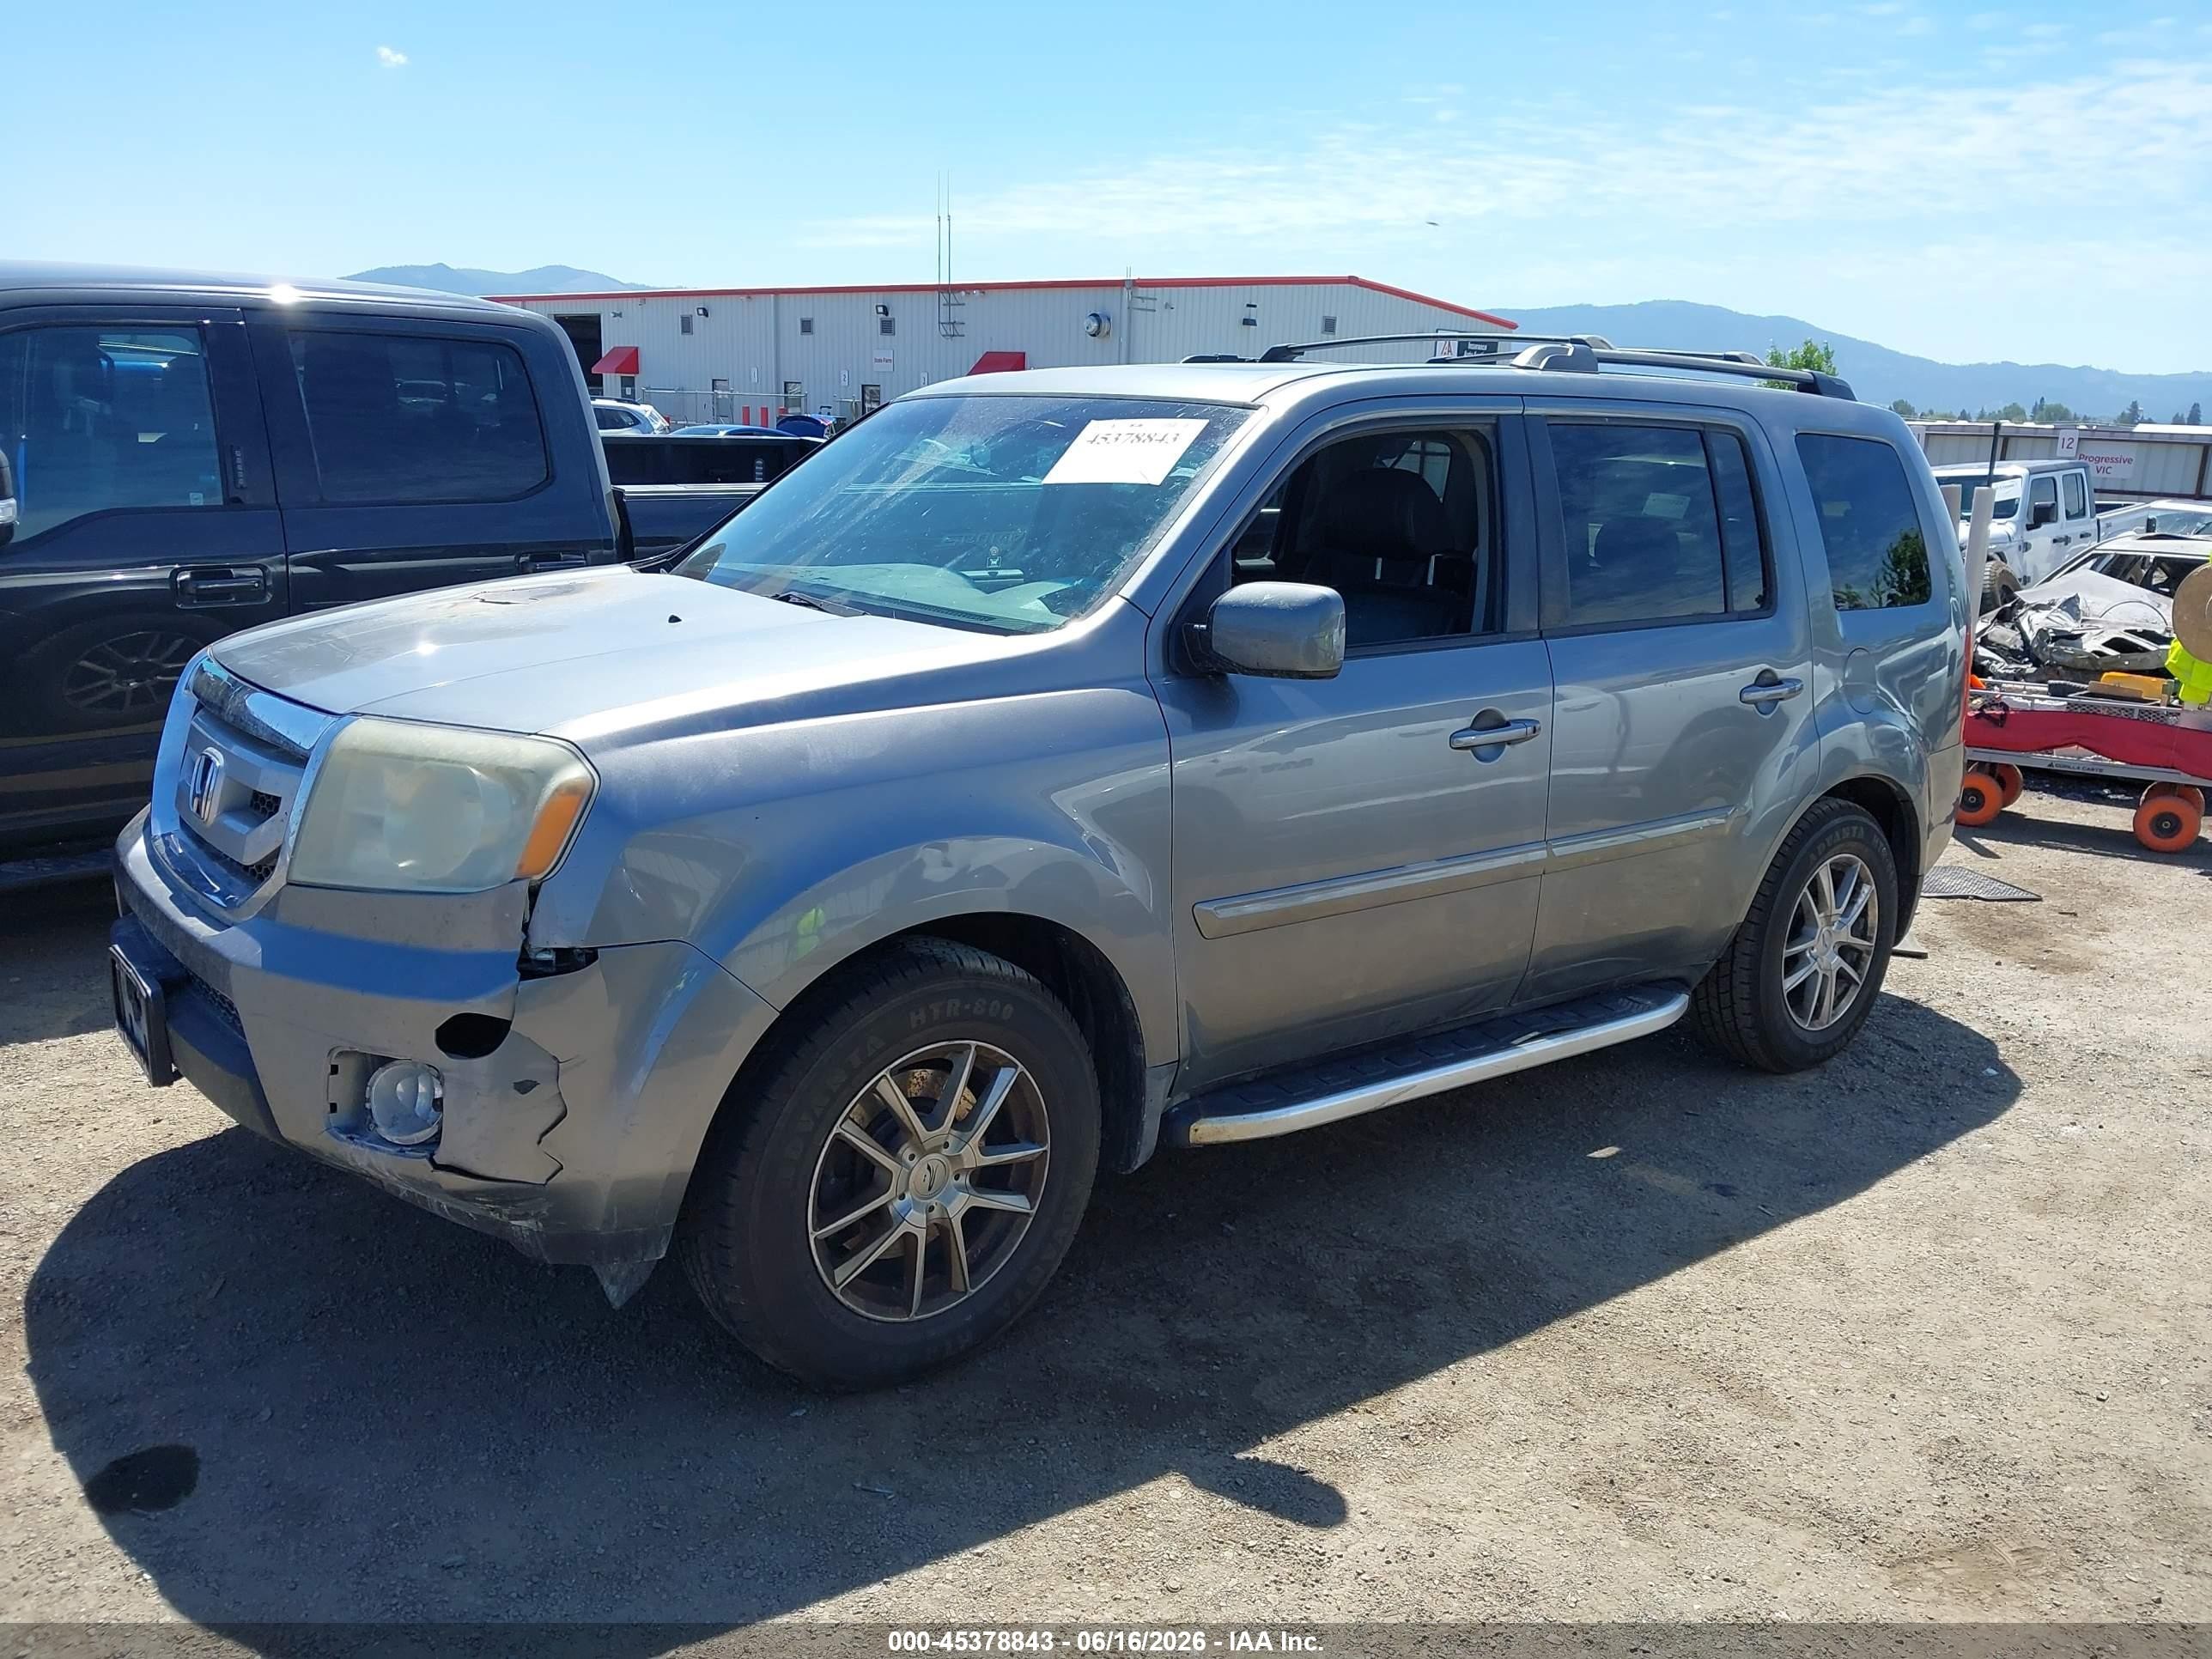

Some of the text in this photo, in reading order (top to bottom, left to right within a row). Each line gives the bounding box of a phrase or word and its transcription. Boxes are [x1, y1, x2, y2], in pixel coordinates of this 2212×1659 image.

[1086, 432, 1180, 445] 45378843
[2061, 437, 2075, 449] 12
[2078, 453, 2134, 465] Progressive
[2095, 465, 2112, 474] VIC
